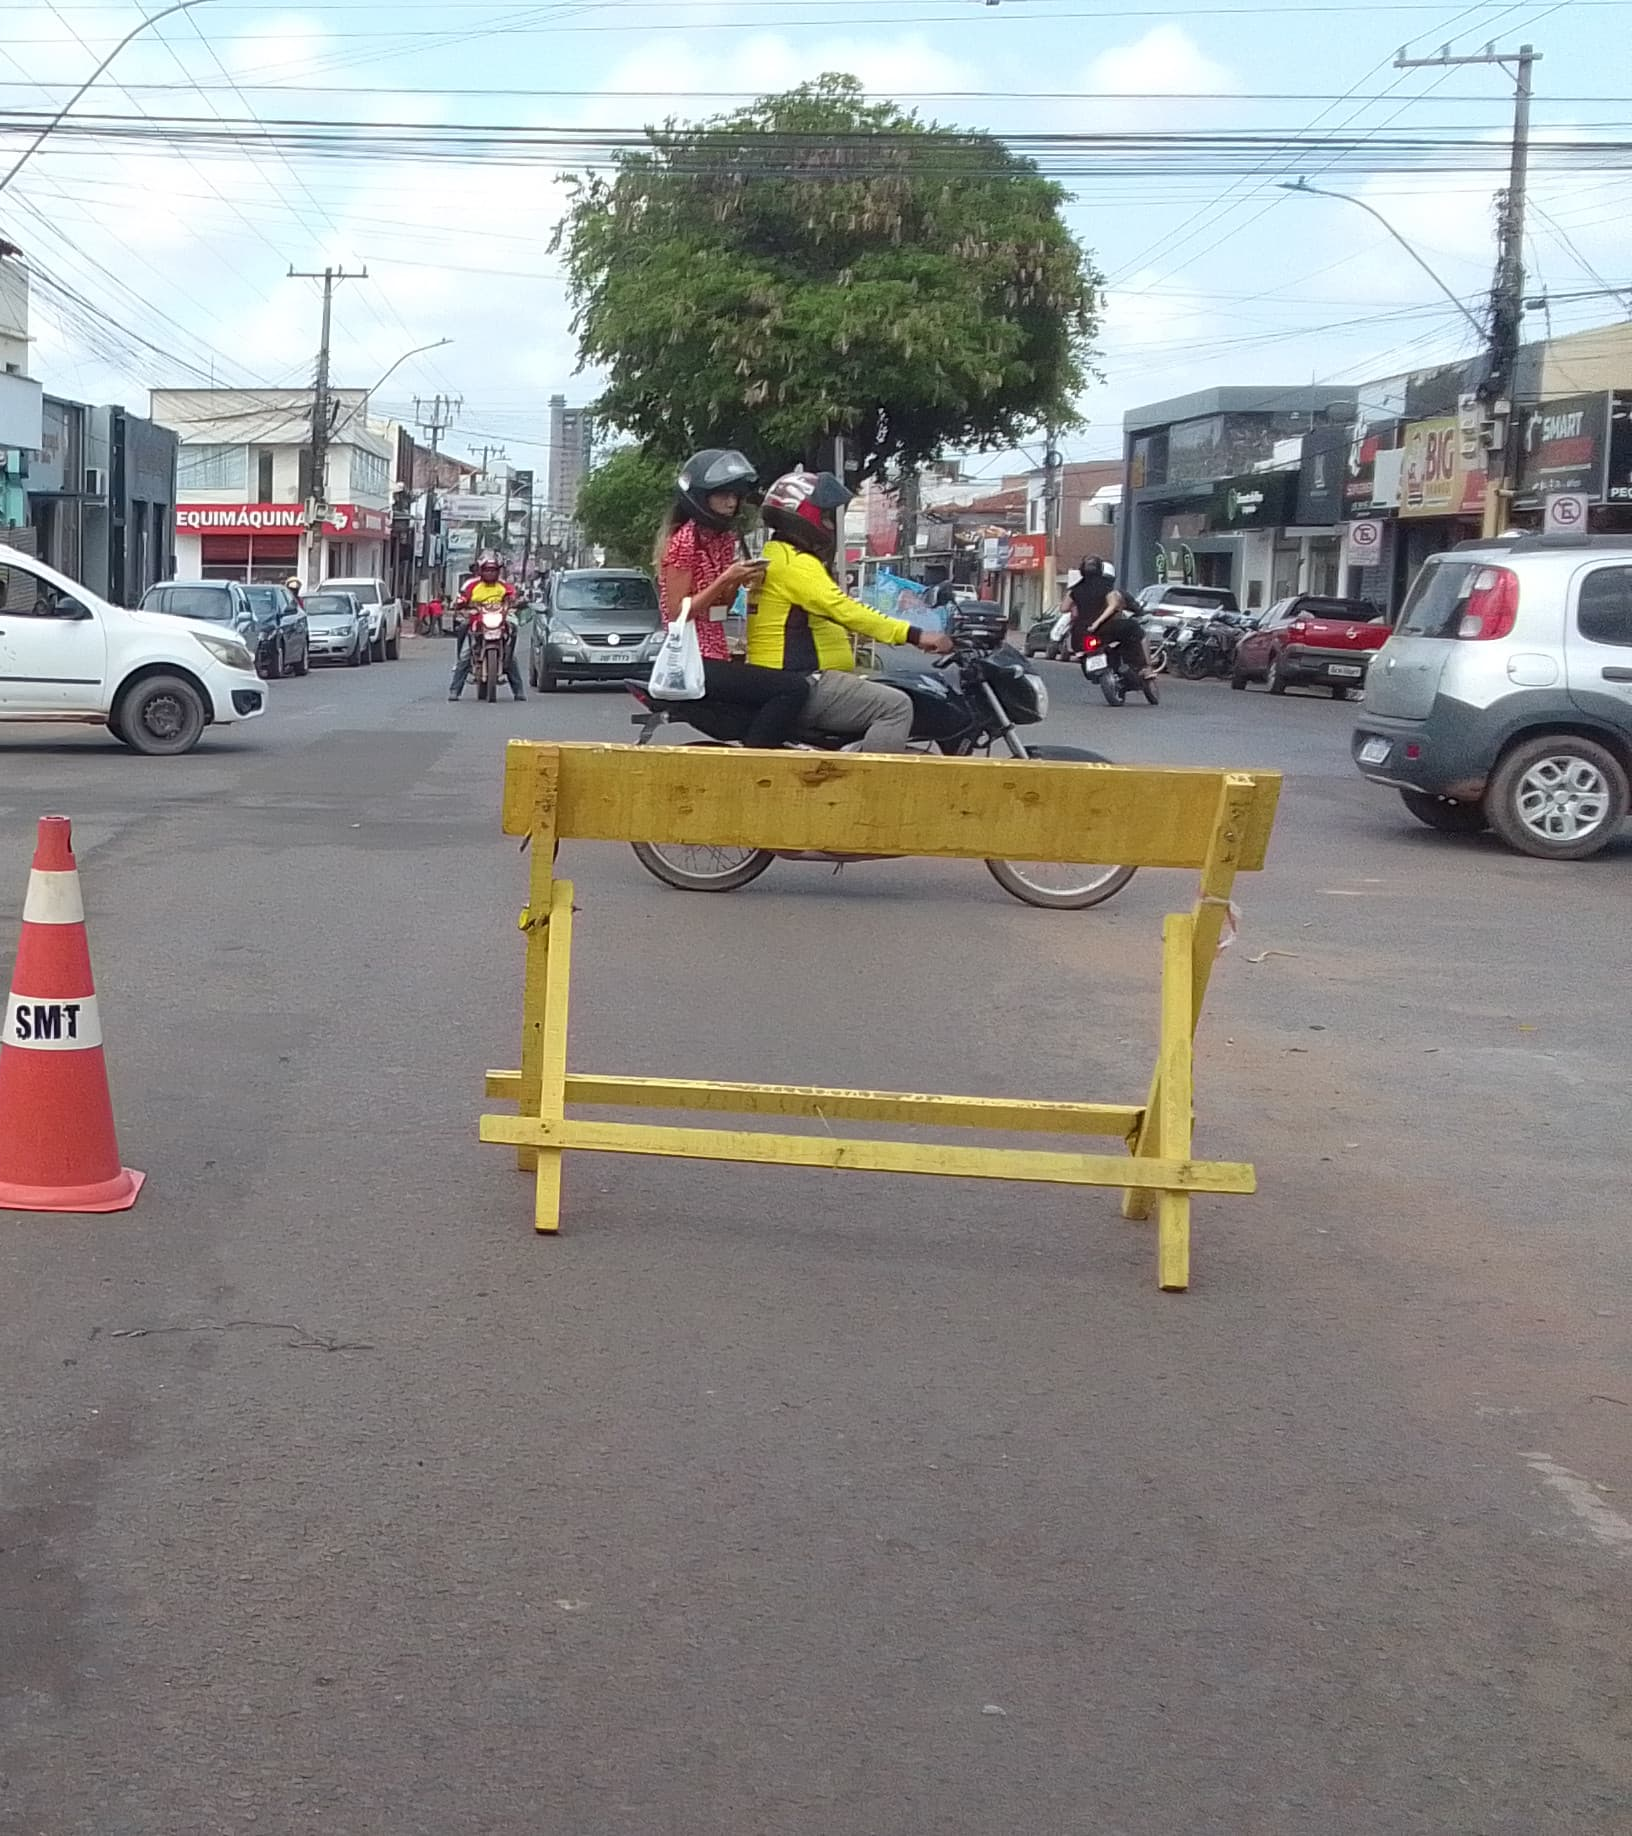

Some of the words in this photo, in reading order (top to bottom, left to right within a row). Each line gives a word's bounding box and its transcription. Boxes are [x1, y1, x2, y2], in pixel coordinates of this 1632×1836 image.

[1543, 411, 1584, 441] SMART
[1425, 427, 1456, 482] BIG
[16, 1004, 80, 1041] SMT
